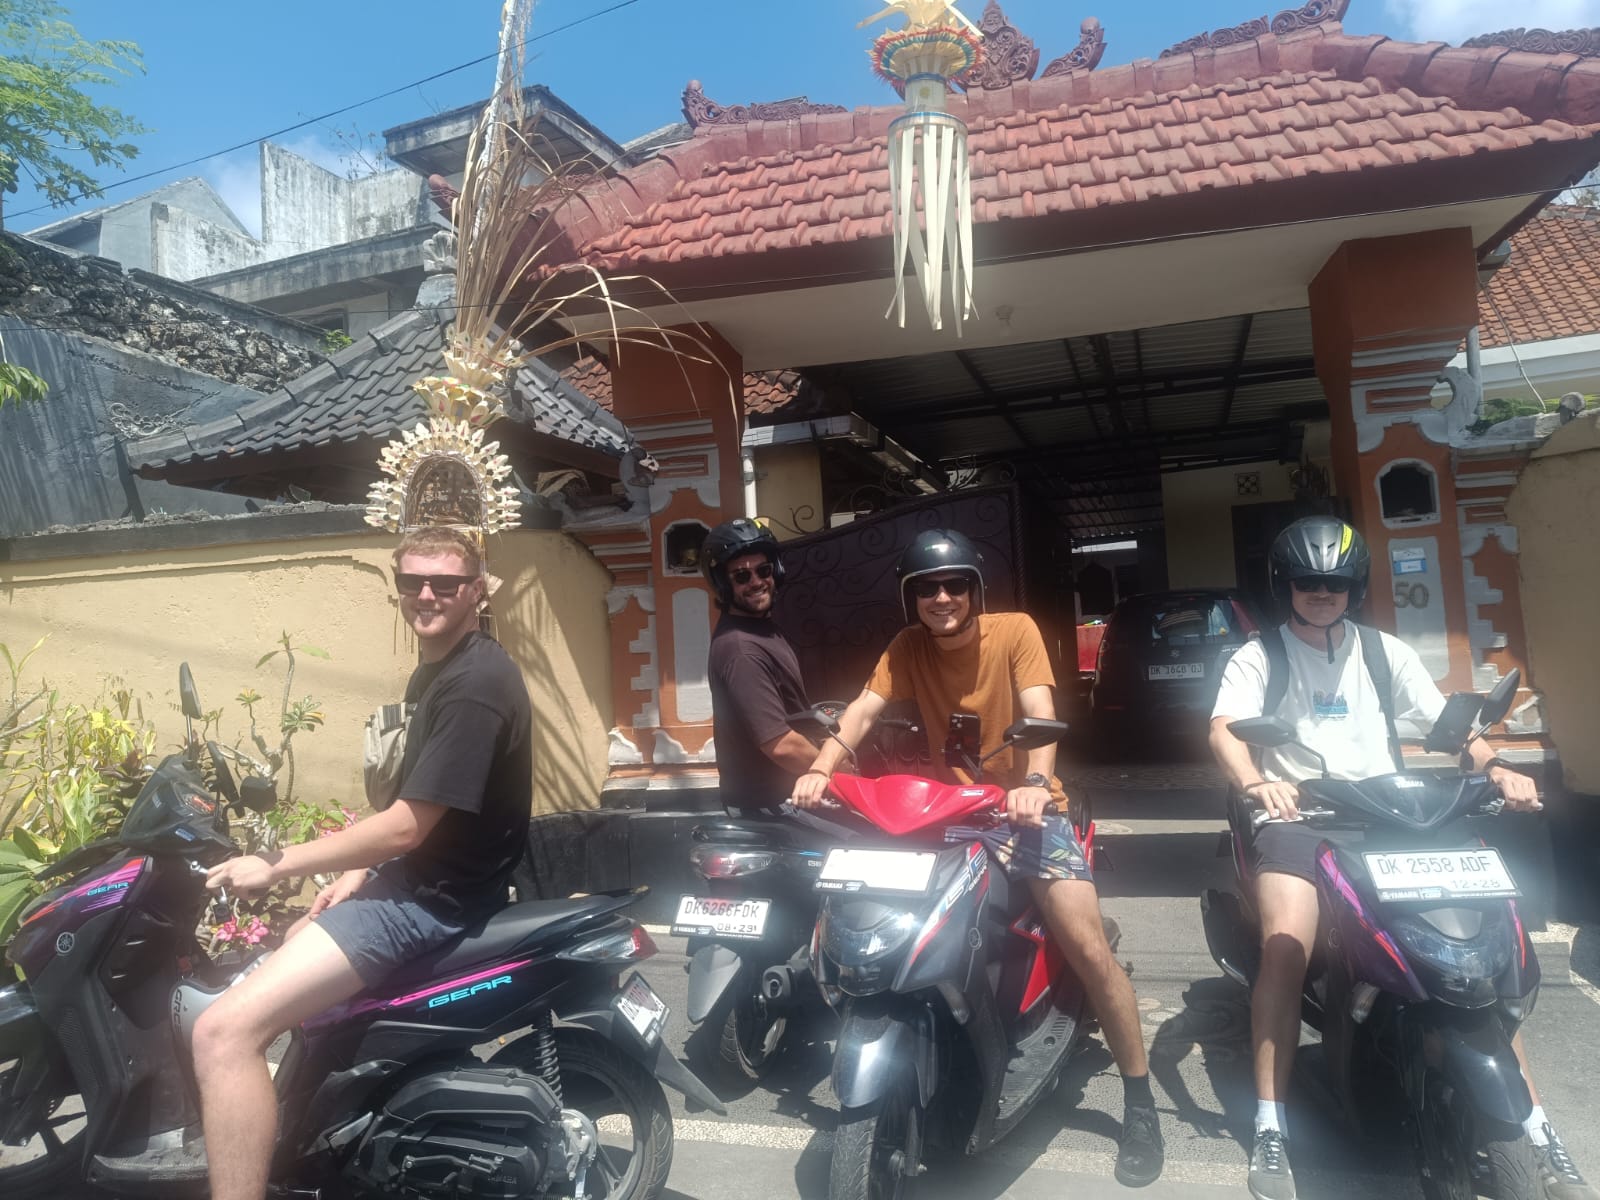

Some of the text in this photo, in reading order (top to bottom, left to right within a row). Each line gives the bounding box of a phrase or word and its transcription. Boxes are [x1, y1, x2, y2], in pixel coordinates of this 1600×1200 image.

[1393, 582, 1429, 609] 50
[1377, 856, 1492, 875] DK 2558 ADF
[87, 881, 129, 896] GEAR
[428, 975, 513, 1009] GEAR
